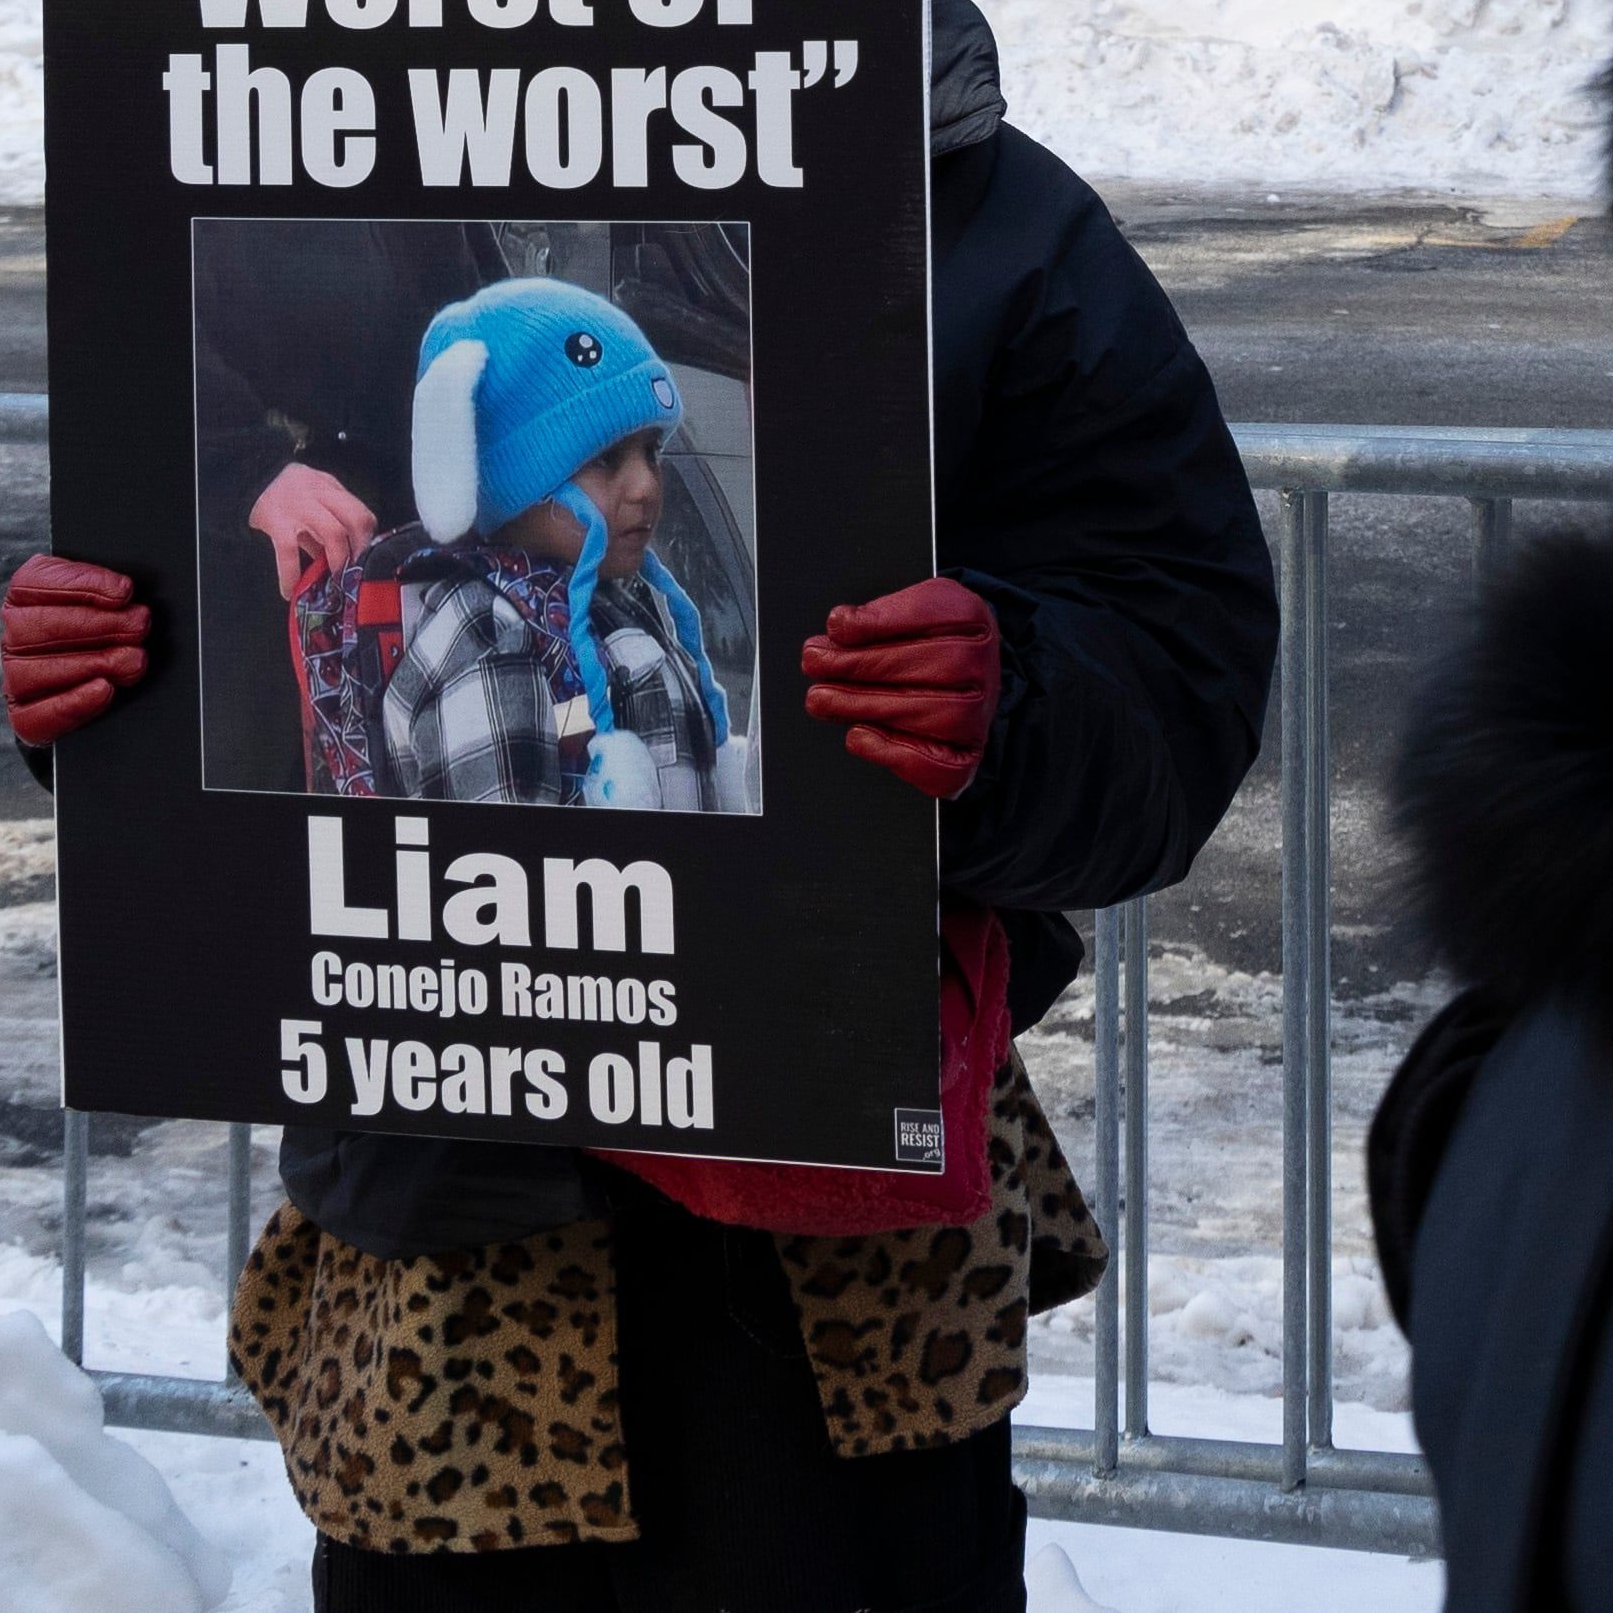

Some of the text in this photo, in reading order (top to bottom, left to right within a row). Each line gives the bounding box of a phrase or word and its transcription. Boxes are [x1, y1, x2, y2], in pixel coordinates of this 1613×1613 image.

[162, 40, 859, 189] the worst”
[307, 815, 675, 954] Liam
[311, 950, 678, 1027] Conejo Ramos
[280, 1018, 715, 1130] 5 years old
[900, 1121, 940, 1135] RISE AND
[900, 1132, 940, 1148] RESIST
